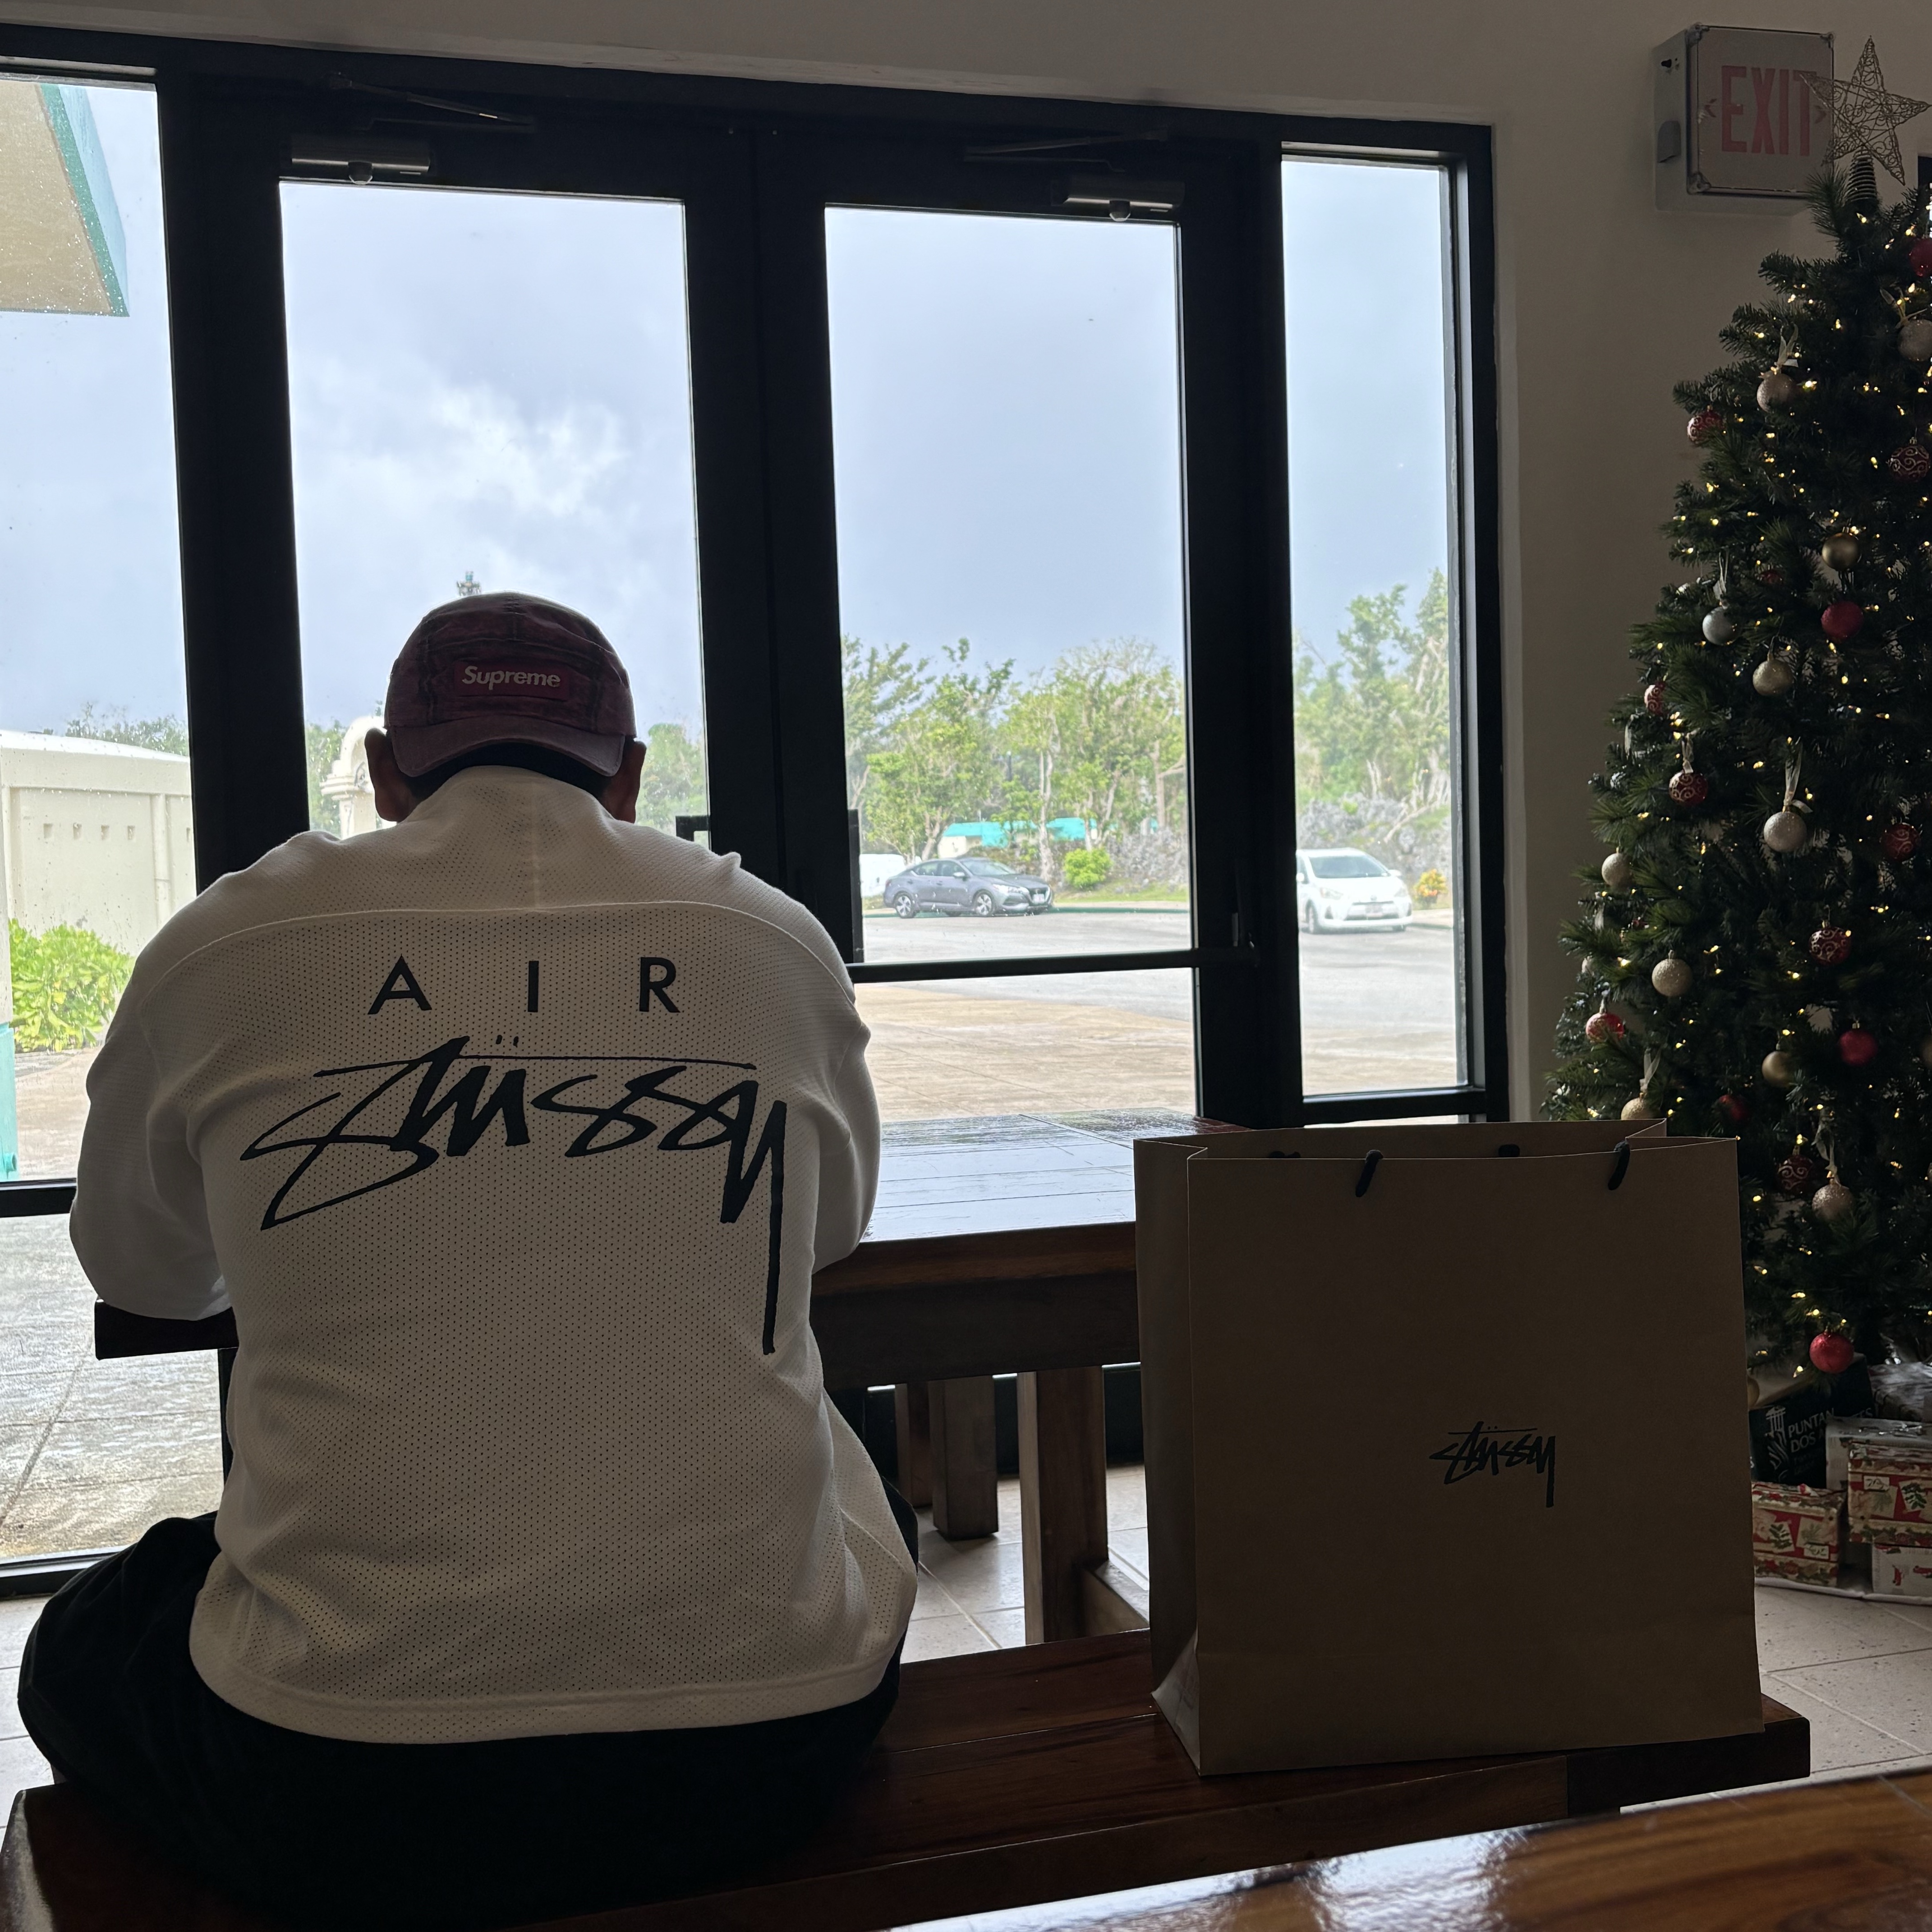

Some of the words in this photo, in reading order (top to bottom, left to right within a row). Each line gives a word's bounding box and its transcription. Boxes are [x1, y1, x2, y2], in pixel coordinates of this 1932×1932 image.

[1721, 65, 1817, 156] EXIT
[462, 665, 561, 690] Supreme
[367, 953, 681, 1015] AIR
[1790, 1431, 1817, 1453] DOS
